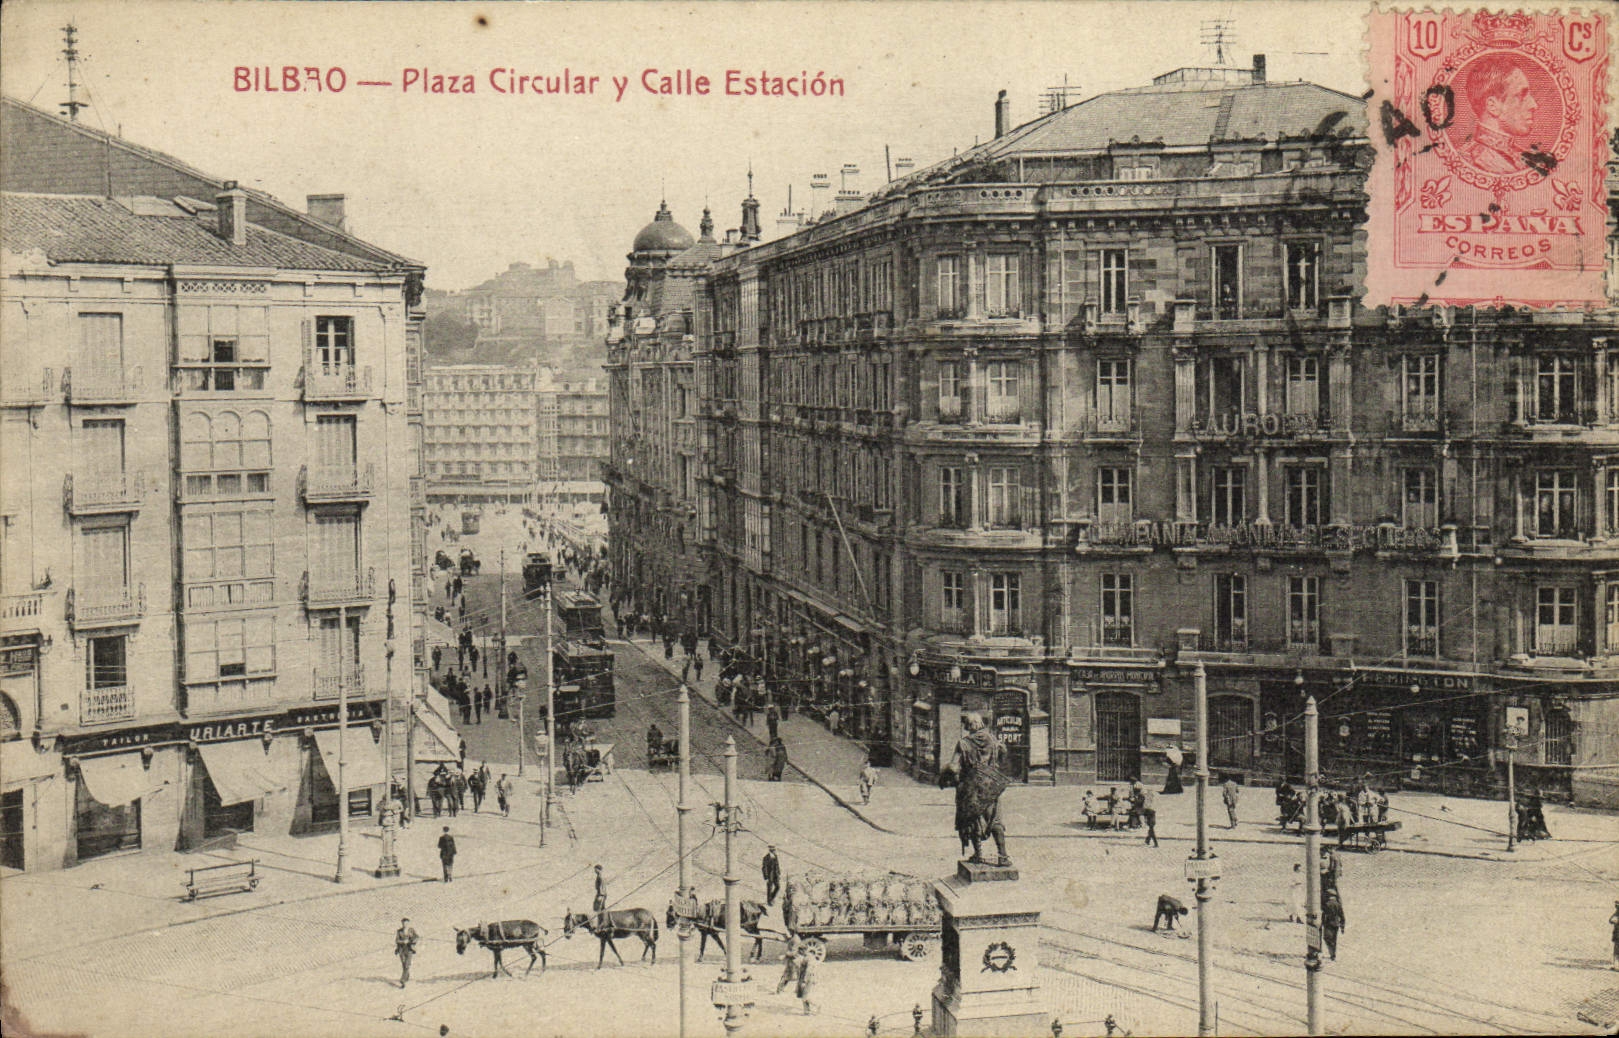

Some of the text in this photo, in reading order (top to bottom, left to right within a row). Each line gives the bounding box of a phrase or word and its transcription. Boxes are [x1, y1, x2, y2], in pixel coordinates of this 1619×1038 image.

[1413, 20, 1438, 50] 10
[1417, 208, 1585, 236] ESPAÑA
[1445, 235, 1551, 260] CORREOS
[103, 733, 149, 747] TAILOR
[189, 719, 275, 742] URIARTE
[998, 733, 1022, 743] SPORT
